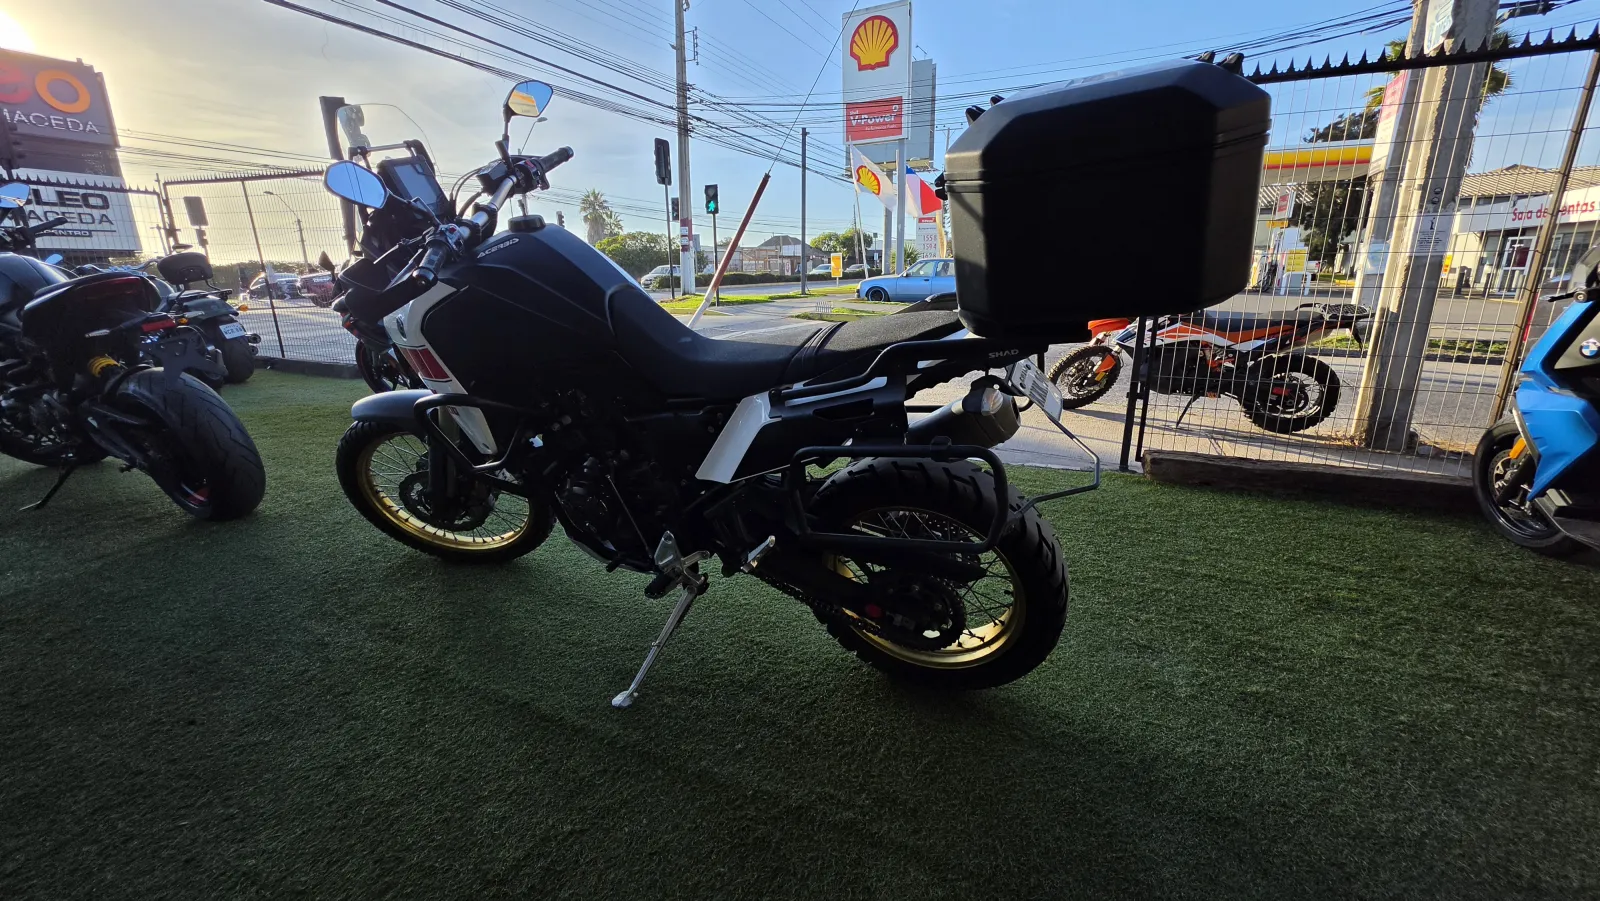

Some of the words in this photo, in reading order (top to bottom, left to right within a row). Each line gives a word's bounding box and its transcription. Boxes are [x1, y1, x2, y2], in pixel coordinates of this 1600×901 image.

[25, 188, 110, 210] LEO
[1561, 200, 1596, 216] entas
[988, 349, 1019, 359] SHAD
